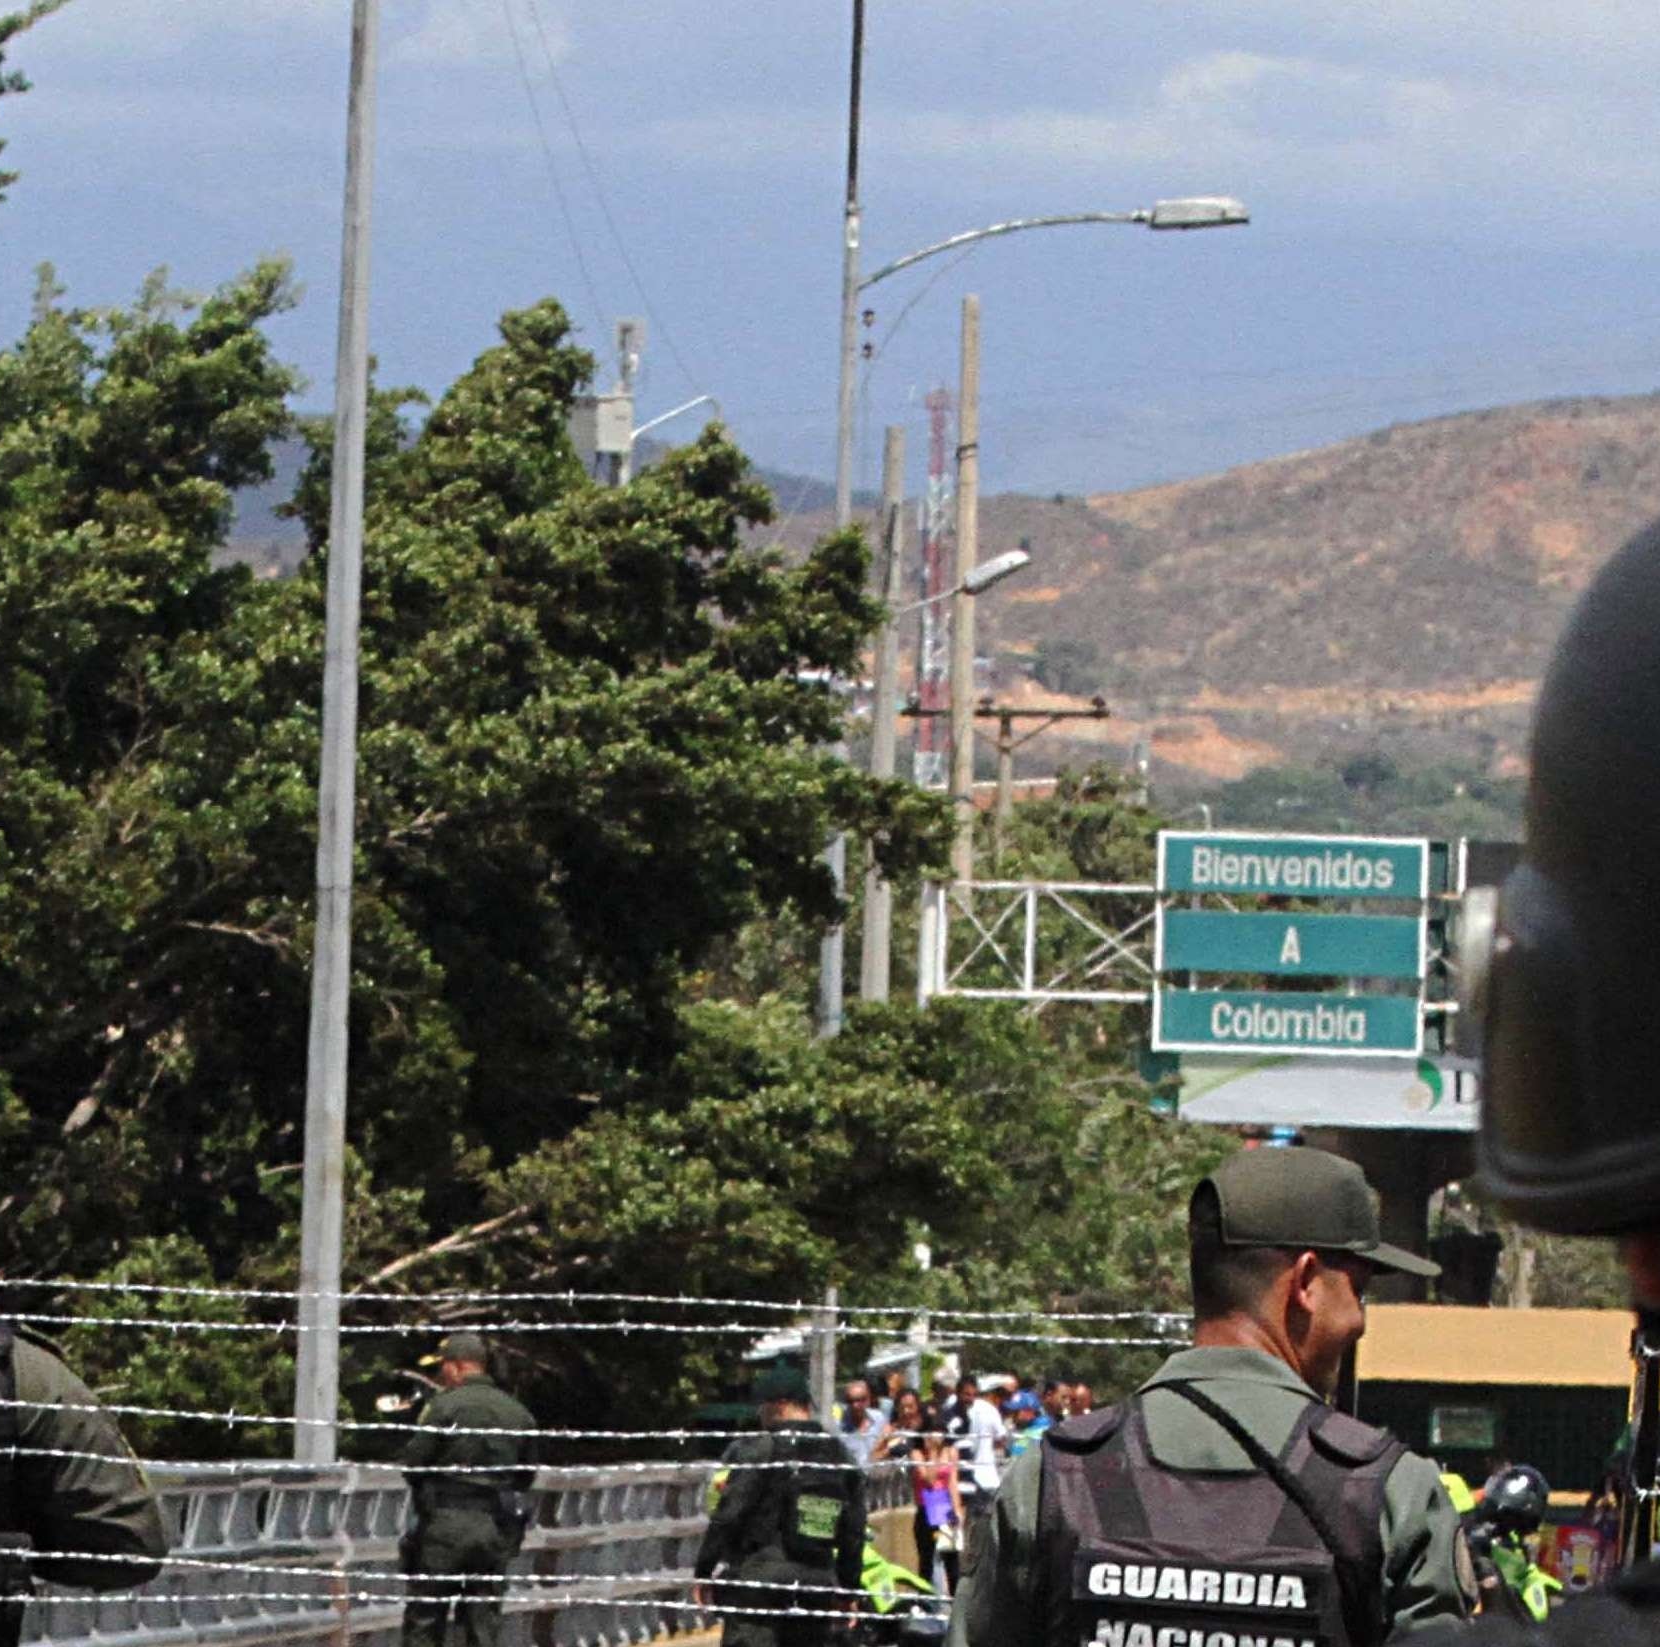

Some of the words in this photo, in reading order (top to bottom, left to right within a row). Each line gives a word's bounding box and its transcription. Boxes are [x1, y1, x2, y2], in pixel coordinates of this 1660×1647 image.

[1192, 846, 1394, 889] Bienvenidos
[1279, 925, 1302, 965] A
[1211, 1001, 1366, 1042] Colombia
[1088, 1562, 1307, 1608] GUARDIA
